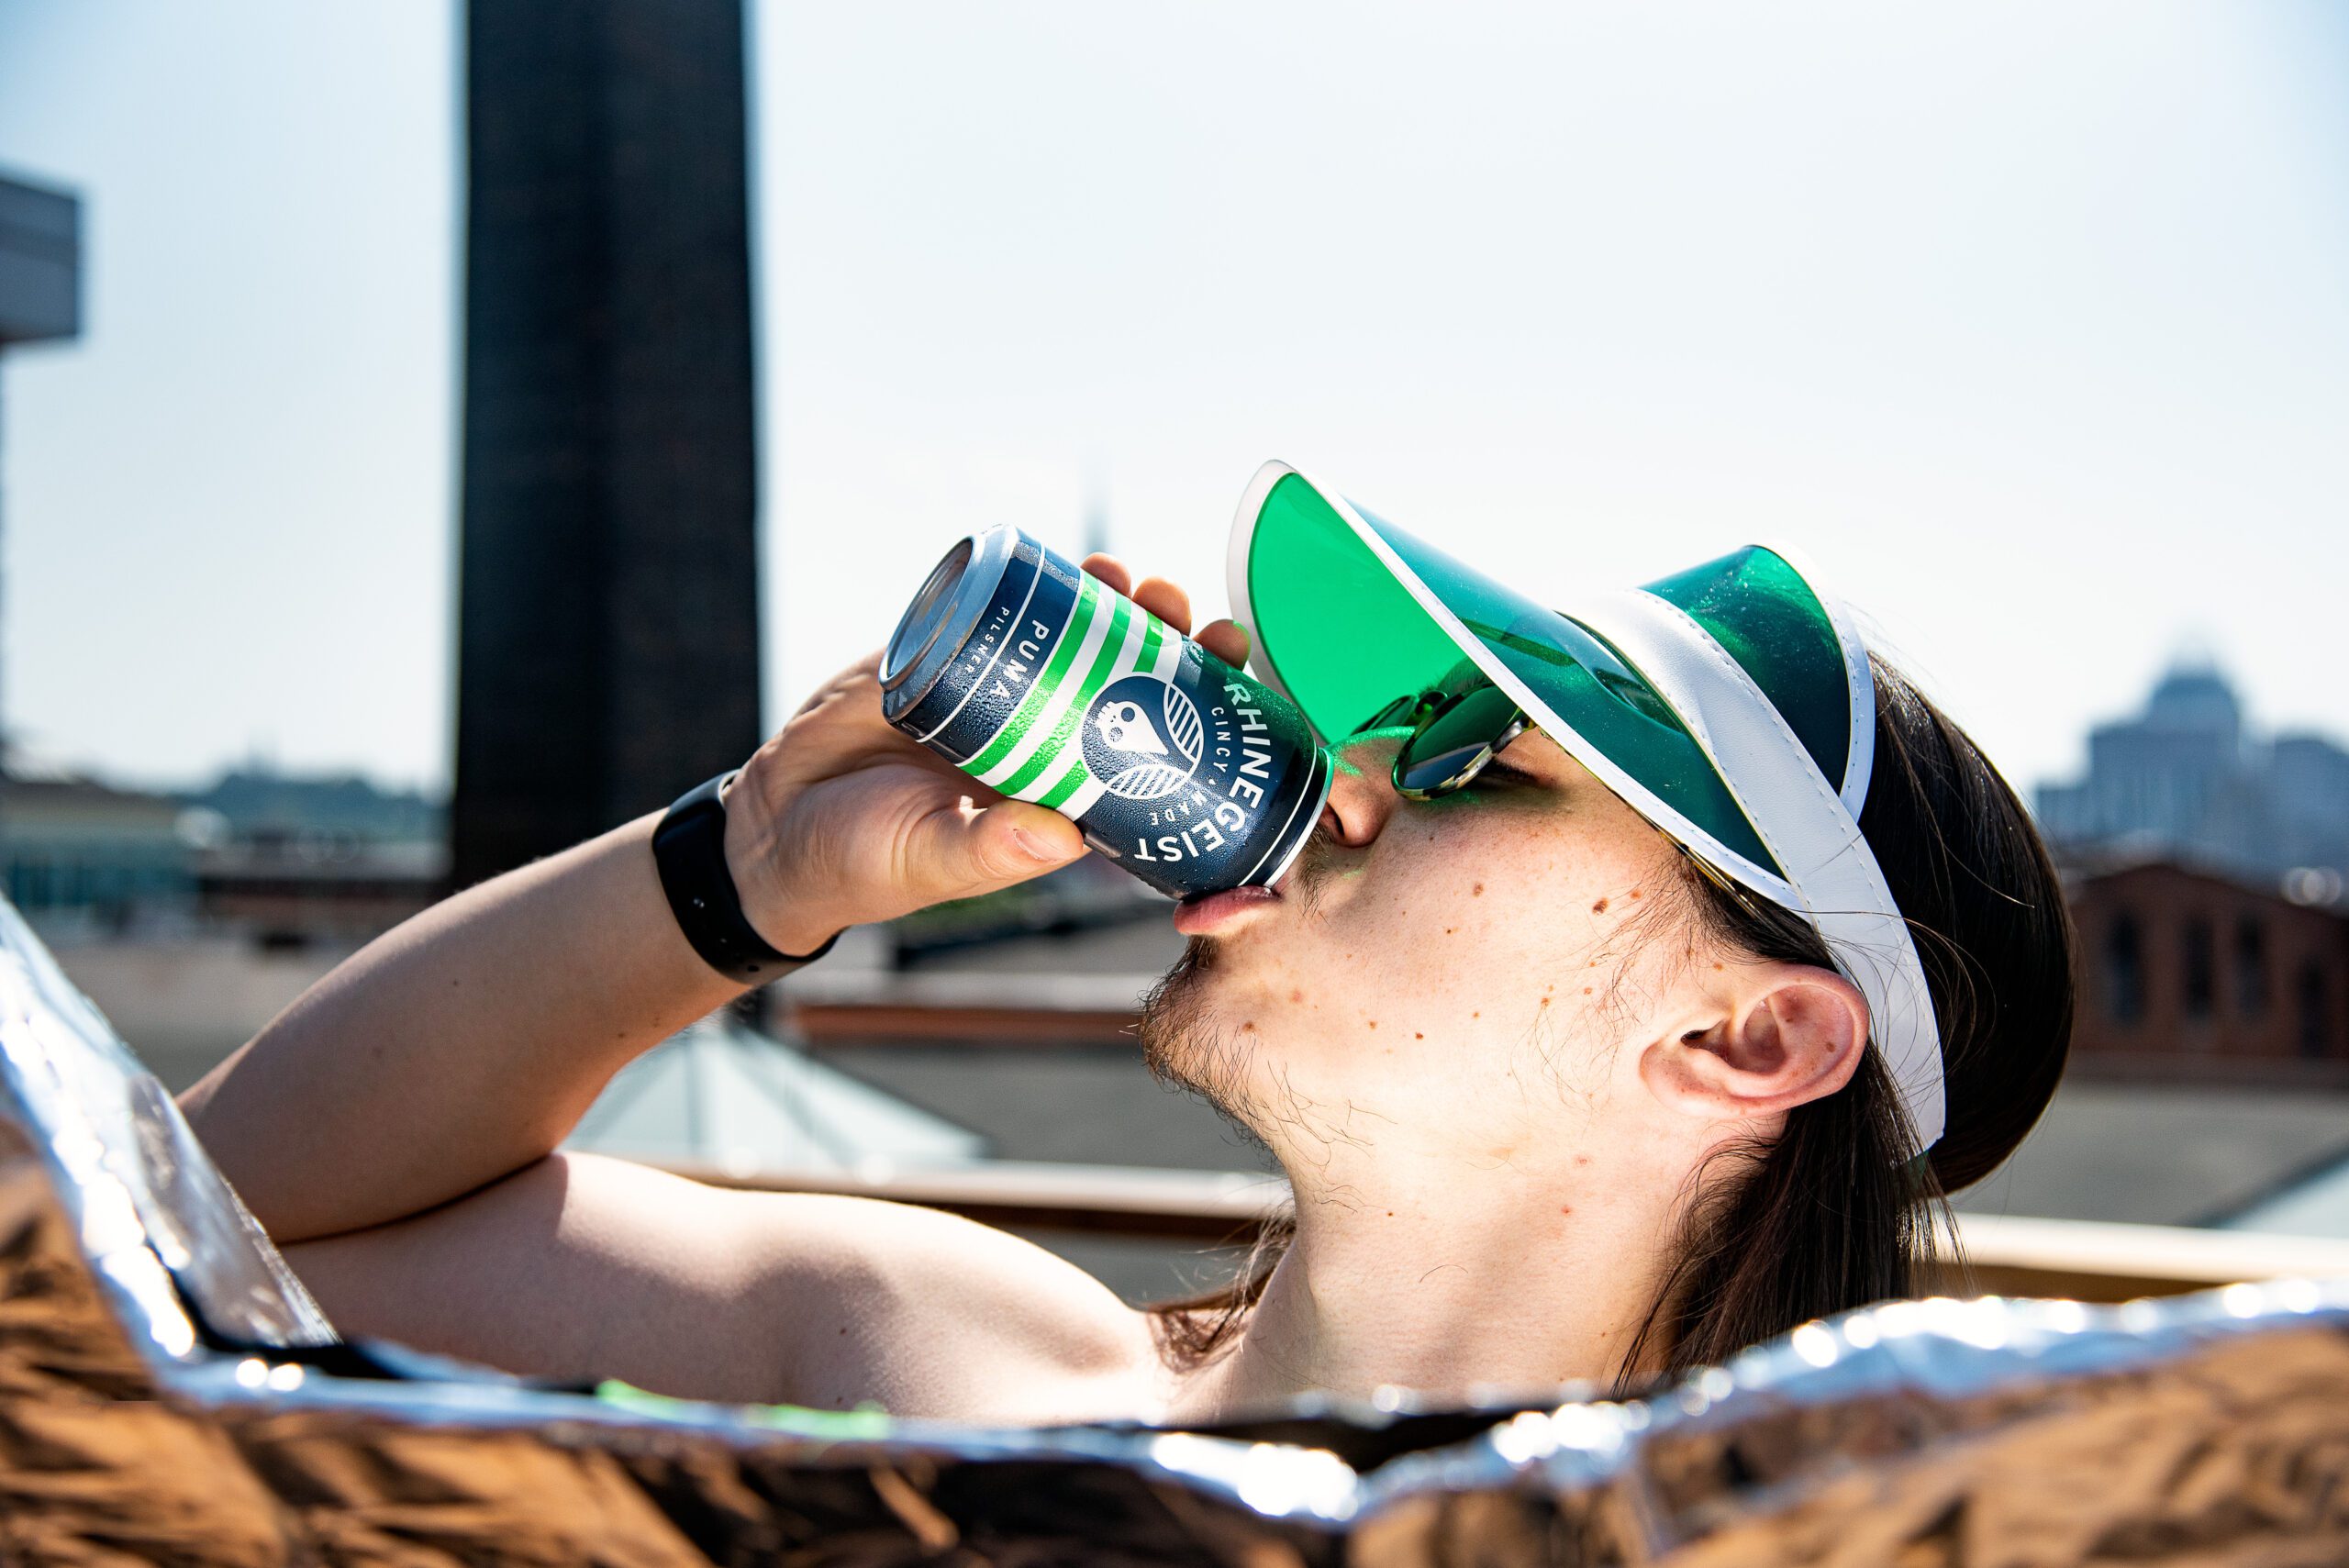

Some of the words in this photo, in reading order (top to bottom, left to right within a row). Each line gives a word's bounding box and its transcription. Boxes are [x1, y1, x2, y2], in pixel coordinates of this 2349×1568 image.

[964, 606, 1010, 673] PILSNER
[990, 619, 1050, 699] PUMA
[1134, 683, 1272, 862] RHINEGEIST
[1211, 706, 1231, 773] CINCY
[1149, 790, 1208, 826] MADE
